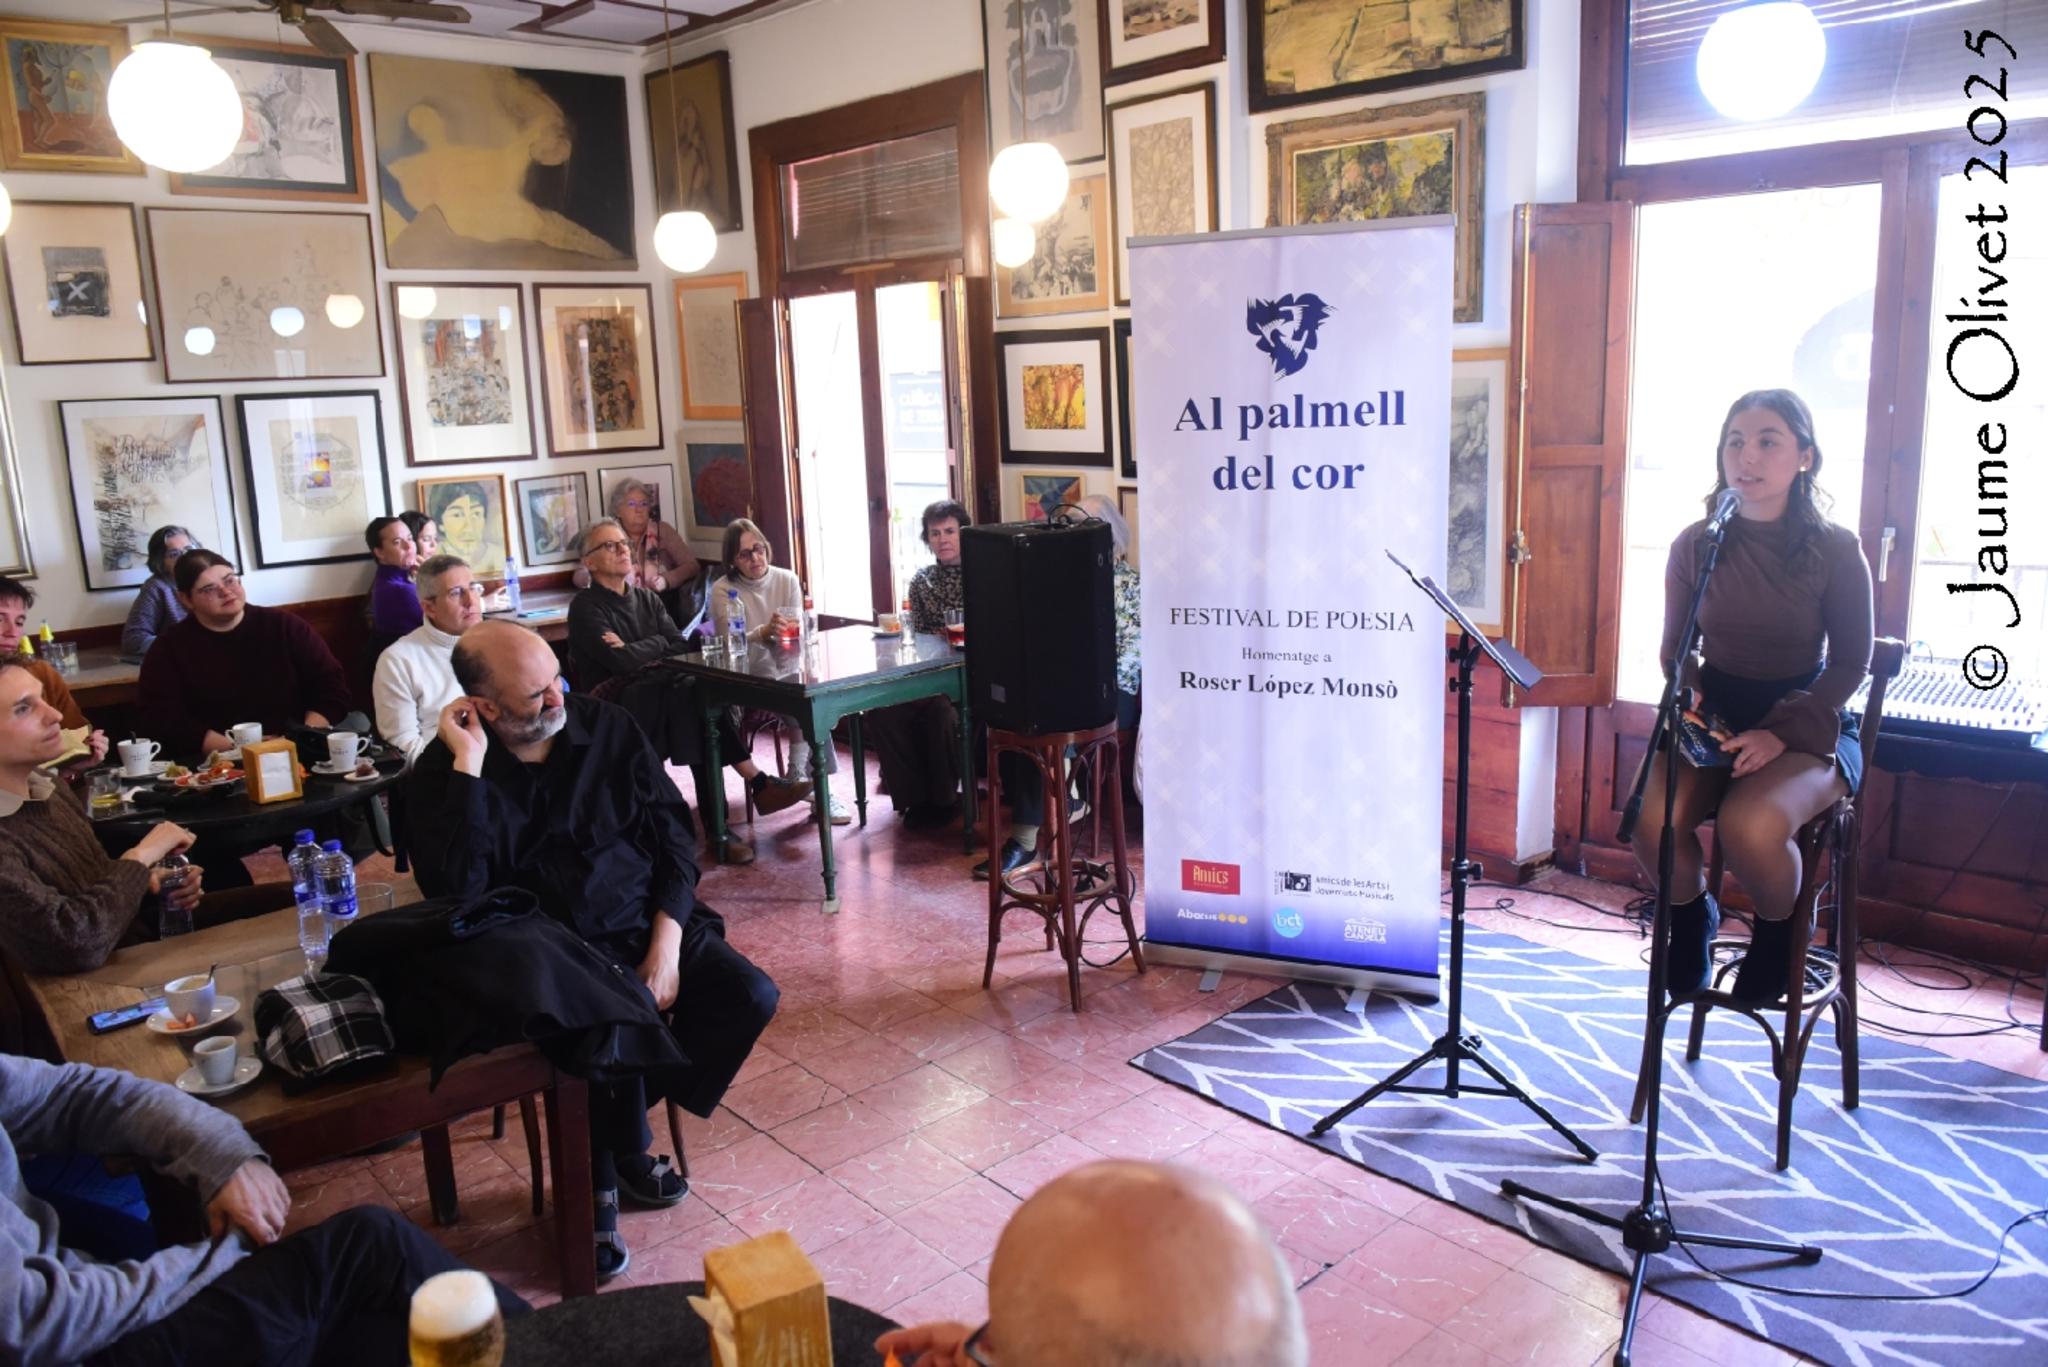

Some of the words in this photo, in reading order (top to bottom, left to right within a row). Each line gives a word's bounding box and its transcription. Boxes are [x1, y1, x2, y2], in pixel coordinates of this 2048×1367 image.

[1173, 396, 1224, 432] Al
[1237, 389, 1407, 441] palmell
[1212, 454, 1276, 491] del
[1291, 462, 1365, 490] cor
[1169, 606, 1279, 628] FESTIVAL
[1287, 610, 1319, 629] DE
[1325, 610, 1416, 633] POESIA
[1241, 647, 1320, 666] Homenatge
[1323, 653, 1332, 663] a
[1179, 670, 1242, 692] Roser
[1247, 674, 1314, 699] López
[1321, 677, 1399, 700] Monsò
[1193, 864, 1230, 884] Amics
[1340, 877, 1352, 887] de
[1353, 878, 1365, 888] les
[1365, 879, 1386, 891] Arts
